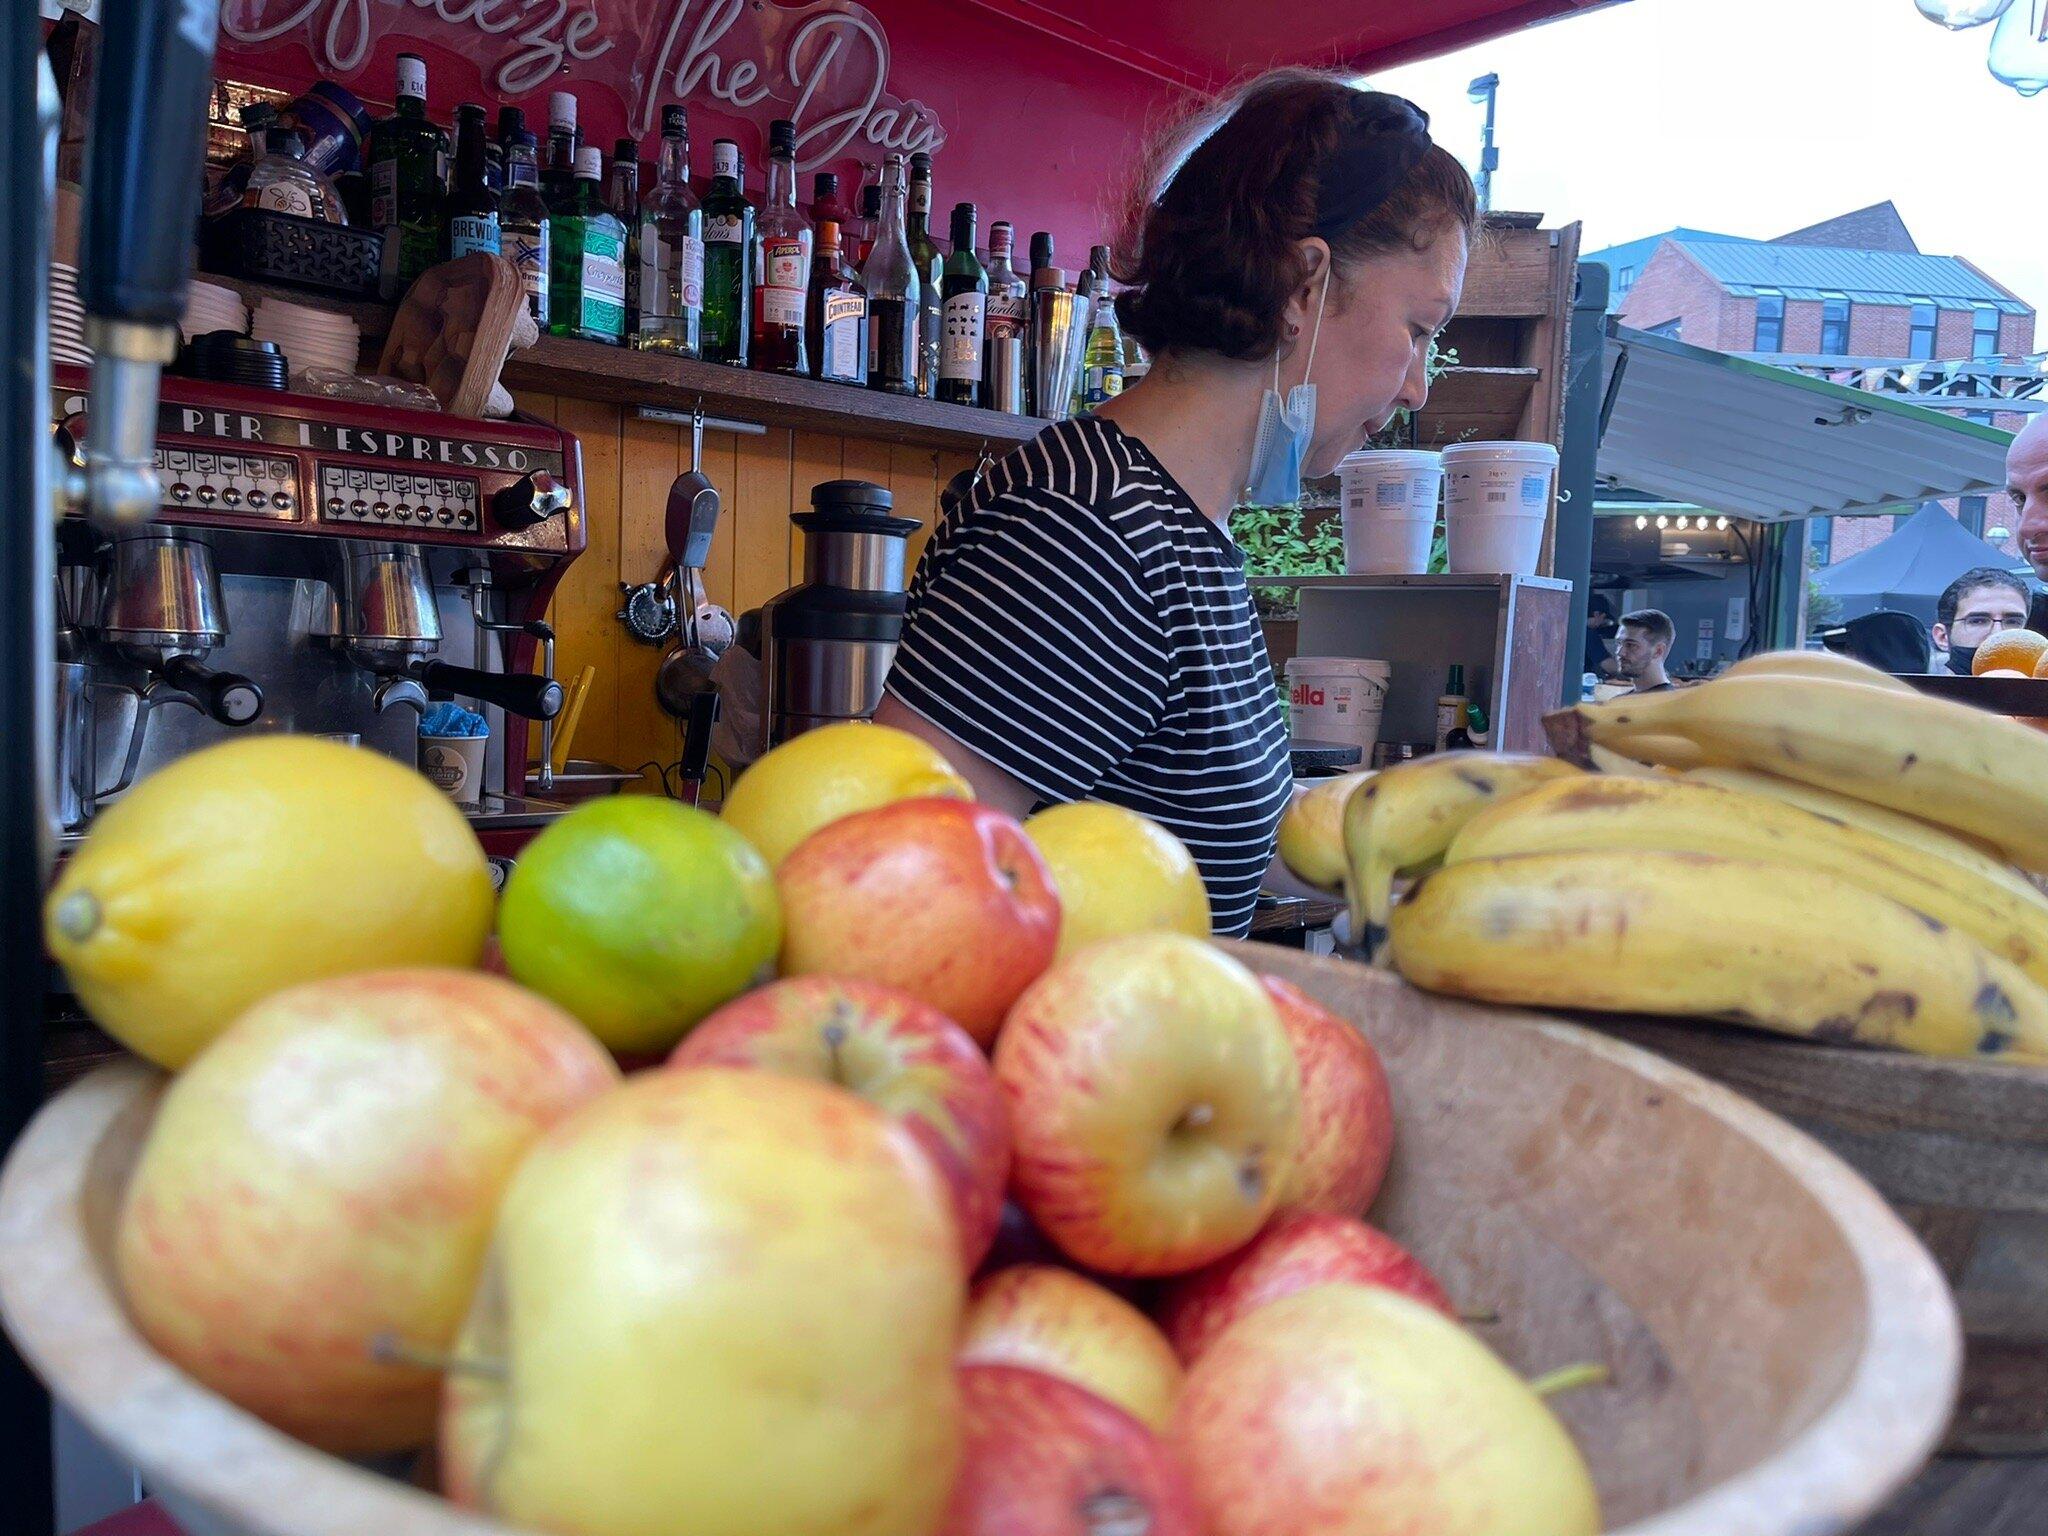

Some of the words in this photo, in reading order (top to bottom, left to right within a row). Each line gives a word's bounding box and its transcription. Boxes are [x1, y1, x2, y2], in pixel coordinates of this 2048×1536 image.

[643, 0, 770, 132] The
[788, 13, 944, 173] Day
[182, 408, 263, 441] PER
[299, 423, 528, 471] L'ESPRESSO
